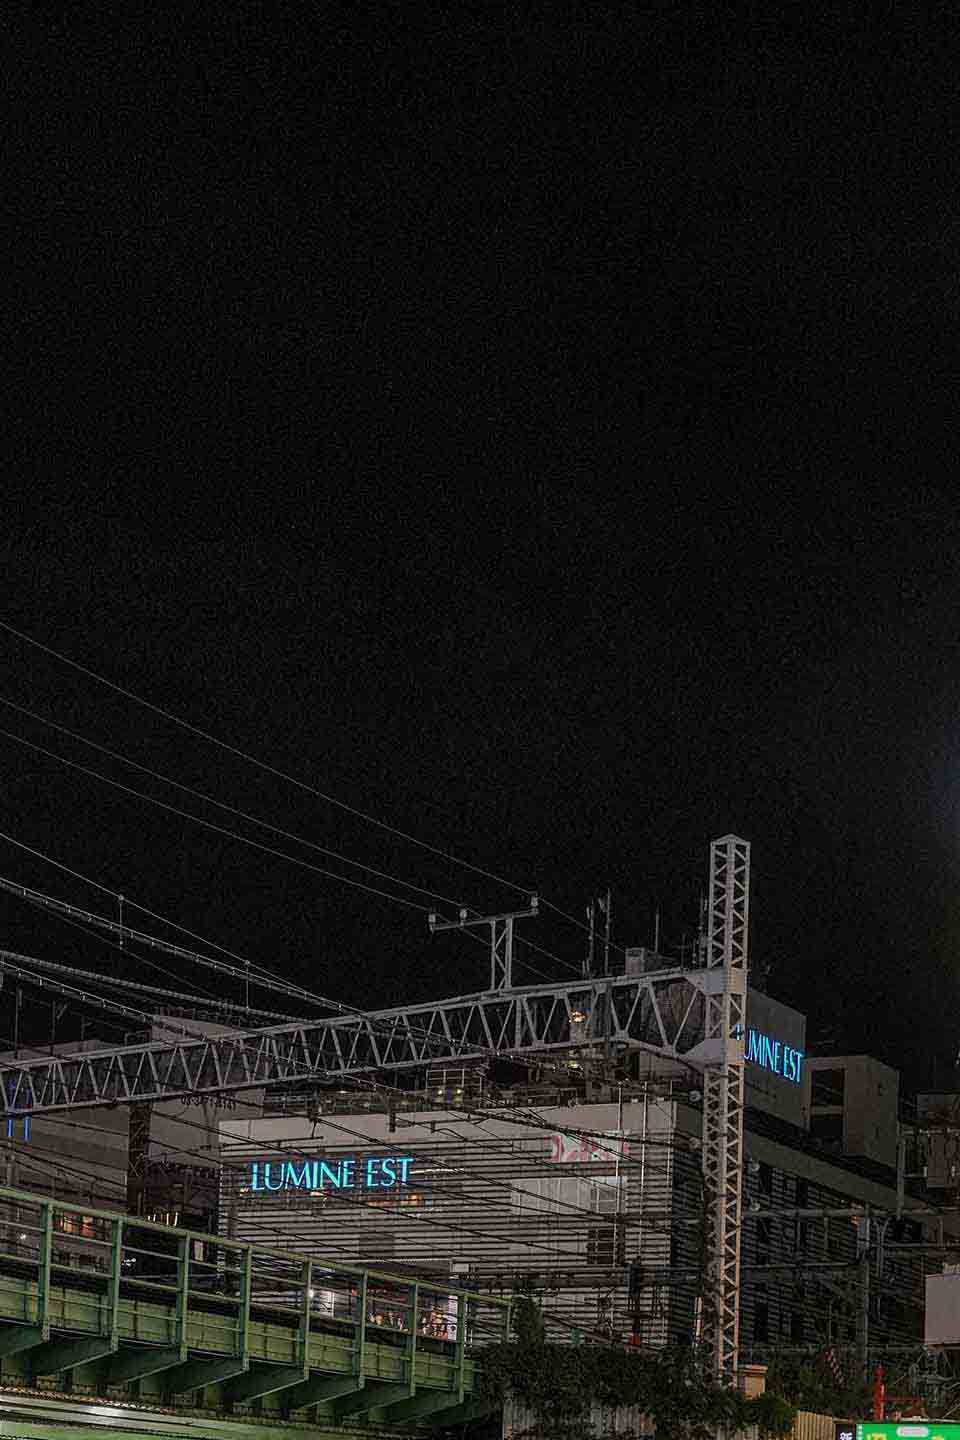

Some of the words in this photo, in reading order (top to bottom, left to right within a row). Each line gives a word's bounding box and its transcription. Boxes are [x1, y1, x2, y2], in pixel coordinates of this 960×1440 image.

[783, 1045, 804, 1083] EST
[252, 1159, 356, 1191] LUMINE
[366, 1157, 414, 1188] EST
